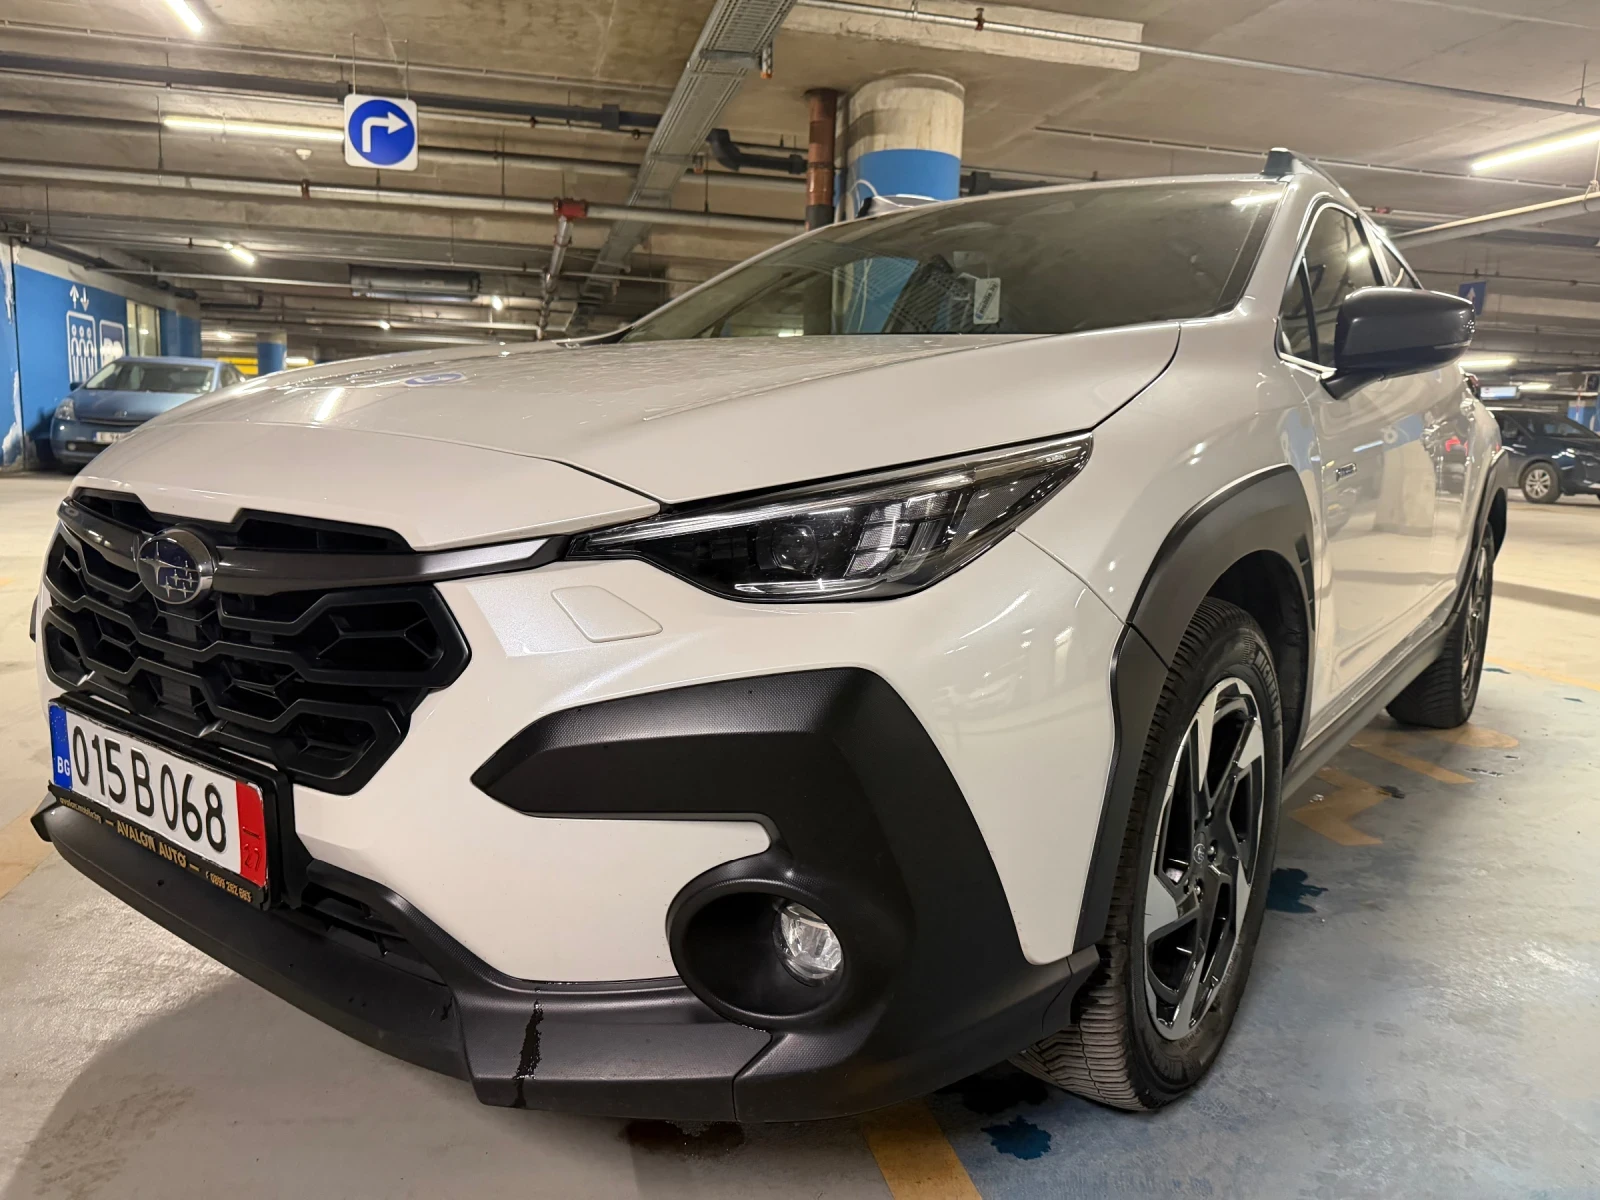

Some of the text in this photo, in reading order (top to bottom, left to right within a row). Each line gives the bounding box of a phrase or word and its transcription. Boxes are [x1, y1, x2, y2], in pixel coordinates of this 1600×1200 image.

[57, 756, 70, 777] BG
[116, 820, 187, 868] AVALON AUTO
